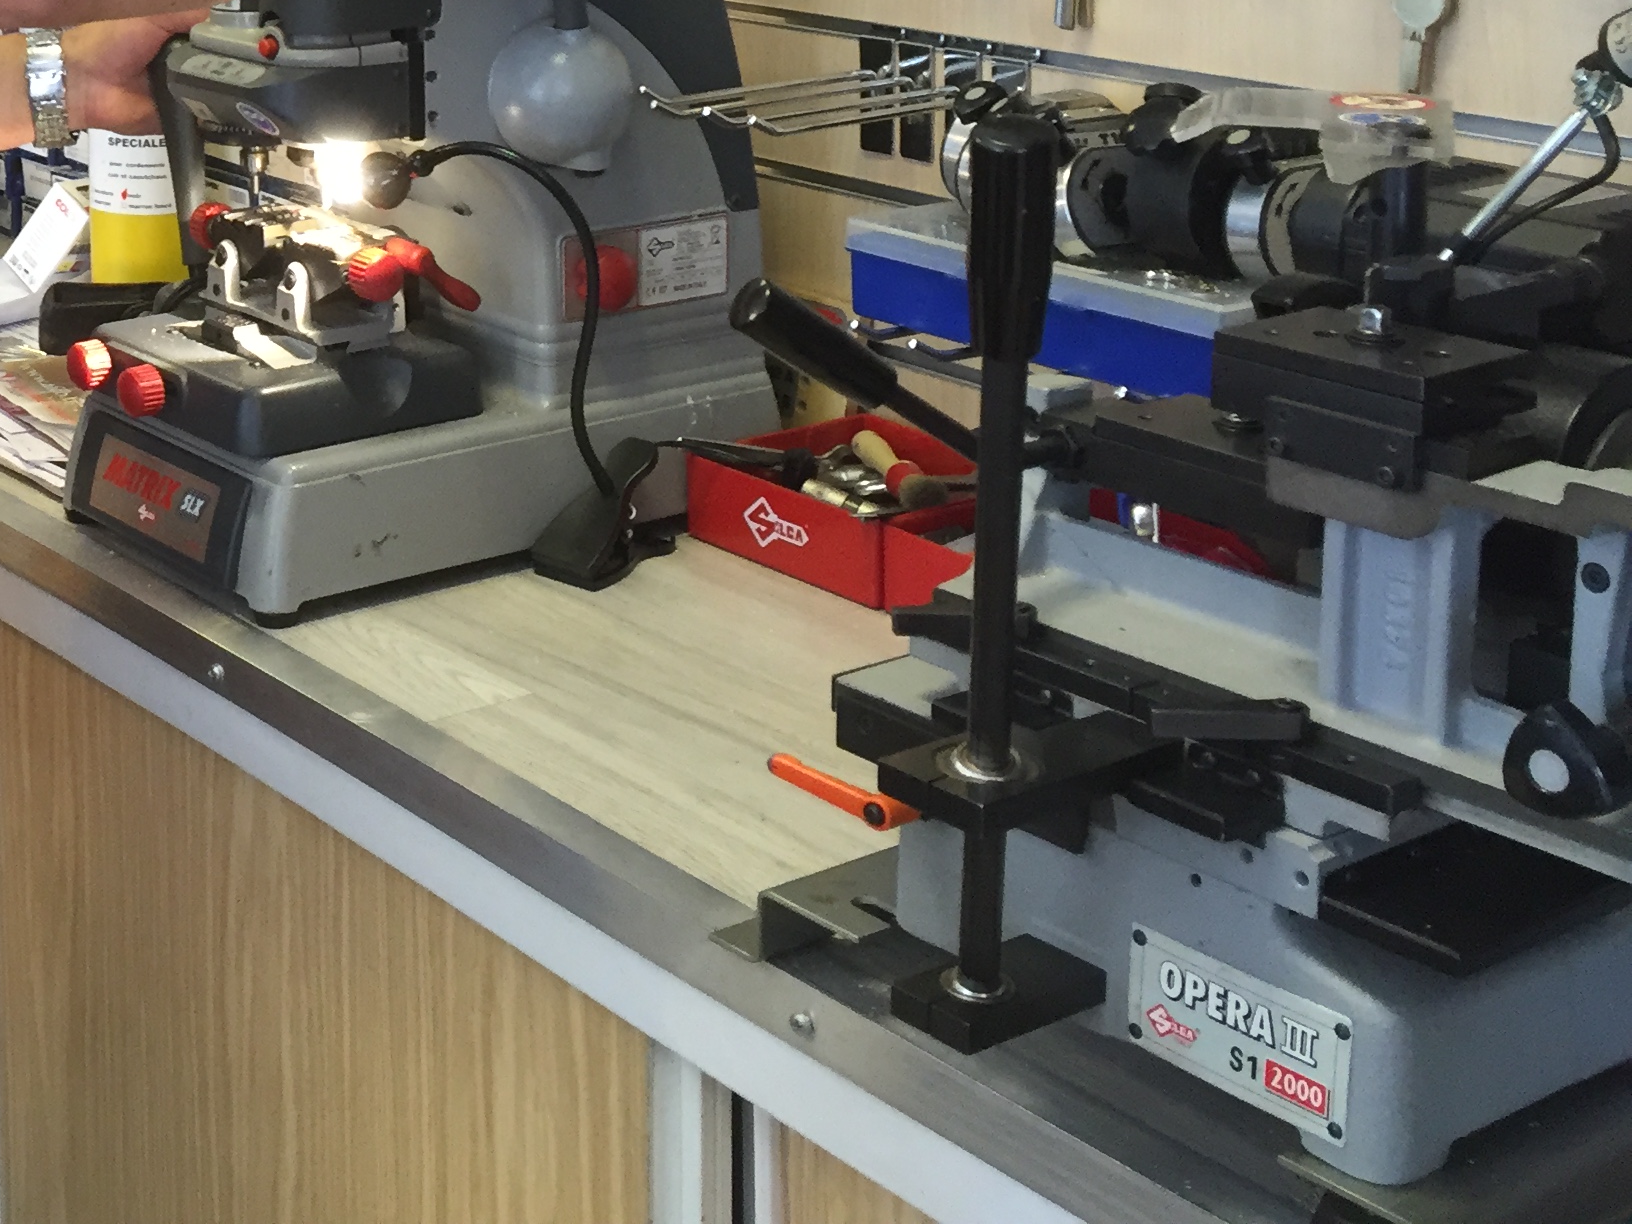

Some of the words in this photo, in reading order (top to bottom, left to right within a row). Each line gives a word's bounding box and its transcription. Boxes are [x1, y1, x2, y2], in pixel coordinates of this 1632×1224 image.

[108, 137, 167, 148] SPECIALE
[103, 453, 181, 511] MATRIX
[180, 494, 204, 517] SLX
[1160, 960, 1276, 1050] OPERA
[1281, 1015, 1320, 1068] III
[1229, 1045, 1258, 1080] S1
[1270, 1066, 1324, 1108] 2000
